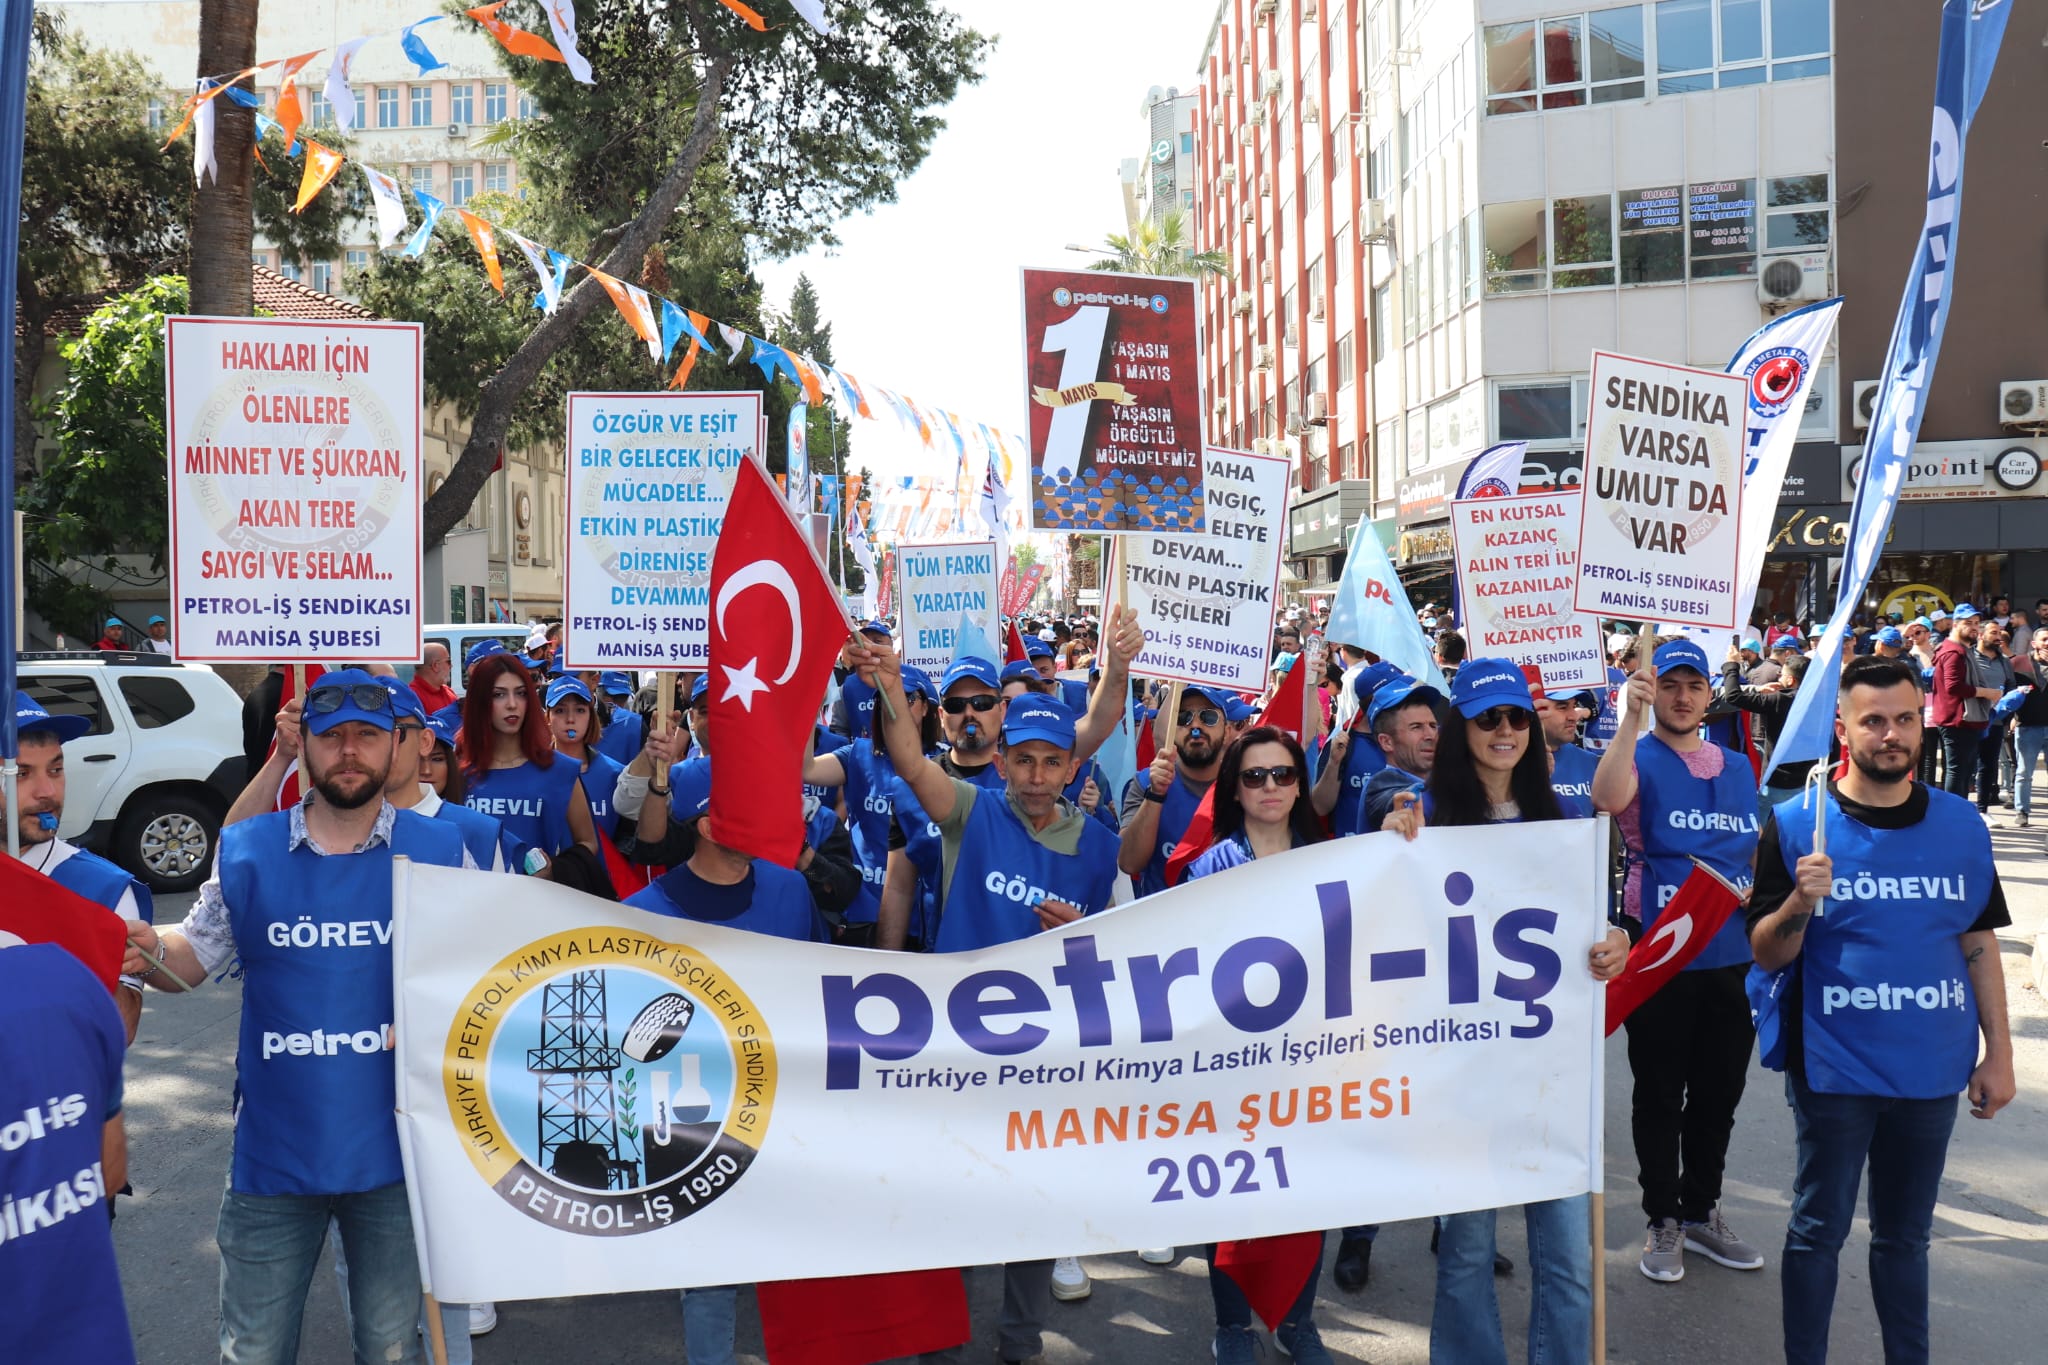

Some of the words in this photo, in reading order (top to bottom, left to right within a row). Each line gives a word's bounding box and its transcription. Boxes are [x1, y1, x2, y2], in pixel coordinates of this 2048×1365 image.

[1625, 199, 1679, 209] TRANSLATION
[1690, 194, 1718, 204] OFFICE
[1641, 189, 1679, 200] ULUSAL
[1073, 292, 1150, 309] petrol-iş
[222, 341, 315, 372] HAKLARI
[325, 336, 369, 381] İÇİN
[1110, 341, 1169, 362] YAŞASIN
[1757, 348, 1788, 363] METAL
[1114, 364, 1121, 378] 1
[1126, 364, 1171, 381] MAYIS
[243, 386, 350, 425] ÖLENLERE
[1060, 383, 1098, 406] MAYIS
[1605, 375, 1730, 428] SENDİKA
[592, 409, 663, 433] ÖZGÜR
[670, 414, 693, 433] VE
[700, 409, 738, 438] EŞİT
[1112, 405, 1171, 425] YAŞASIN
[1110, 423, 1175, 445] ÖRGÜTLÜ
[1619, 423, 1711, 469] VARSA
[185, 438, 271, 475] MİNNET
[279, 447, 305, 476] VE
[312, 440, 407, 484] ŞÜKRAN,
[581, 443, 612, 468] BİR
[619, 448, 700, 468] GELECEK
[1096, 445, 1196, 468] MÜCADELEMİZ
[1783, 475, 1805, 486] vice
[1907, 458, 1980, 481] point
[2001, 467, 2036, 476] Rental
[603, 478, 724, 502] MÜCADELE...
[1208, 488, 1266, 517] NGIÇ,
[1596, 466, 1680, 508] UMUT
[1688, 480, 1728, 516] DA
[238, 499, 300, 528] AKAN
[308, 500, 356, 529] TERE
[580, 512, 637, 536] ETKİN
[644, 511, 723, 537] PLASTİK
[1471, 508, 1494, 524] EN
[1500, 503, 1566, 522] KUTSAL
[1211, 519, 1268, 543] ELEYE
[1485, 528, 1557, 547] KAZANÇ
[1630, 517, 1687, 555] VAR
[201, 551, 265, 580] SAYGI
[272, 551, 298, 580] VE
[306, 552, 393, 580] SELAM...
[619, 547, 707, 576] DİRENİŞE
[905, 552, 940, 577] TÜM
[946, 554, 991, 576] FARKI
[1152, 538, 1243, 569] DEVAM...
[1468, 556, 1509, 573] ALIN
[1513, 549, 1550, 569] TERİ
[1188, 575, 1270, 603] PLASTİK
[1582, 563, 1652, 585] PETROL-İŞ
[1656, 572, 1731, 594] SENDİKASI
[185, 593, 290, 619] PETROL-İŞ
[299, 593, 411, 615] SENDİKASI
[913, 590, 986, 613] YARATAN
[1151, 595, 1232, 626] İŞÇİLERİ
[1503, 602, 1557, 620] HELAL
[1600, 590, 1657, 610] MANİSA
[1661, 596, 1710, 616] ŞUBESİ
[573, 613, 657, 634] PETROL-İŞ
[1484, 624, 1583, 646] KAZANÇTIR
[216, 625, 302, 647] MANİSA
[309, 625, 381, 651] ŞUBESİ
[597, 640, 665, 657] MANİSA
[670, 643, 711, 661] ŞUBE
[1143, 629, 1183, 649] OL-İŞ
[1186, 636, 1264, 660] SENDİKASI
[1190, 660, 1240, 679] ŞUBESİ
[1536, 649, 1598, 664] SENDİKASI
[1543, 666, 1583, 685] ŞUBESİ
[1553, 781, 1591, 798] REVLİ
[465, 795, 543, 817] ÖREVLİ
[1668, 808, 1760, 834] GÖREVLİ
[1830, 871, 1965, 902] GÖREVLİ
[267, 915, 393, 948] GÖREV
[510, 939, 582, 984] KİMYA
[588, 937, 665, 964] LASTİK
[669, 949, 747, 1021] İŞÇİLERİ
[821, 870, 1563, 1092] petrol-iş
[1823, 978, 1965, 1015] petrol-iş
[458, 982, 513, 1060] PETROL
[263, 1023, 392, 1060] petrol
[876, 1066, 988, 1093] Türkiye
[998, 1059, 1085, 1086] Petrol
[1095, 1055, 1183, 1085] Kimya
[1193, 1040, 1273, 1073] Lastik
[1282, 1027, 1366, 1066] İşçileri
[1372, 1017, 1502, 1049] Sendikası
[737, 1024, 765, 1133] SENDİKASI
[0, 1093, 87, 1151] ol-iş
[455, 1066, 500, 1163] TÜRKİYE
[1147, 1146, 1291, 1204] 2021
[510, 1174, 675, 1230] PETROL-İŞ
[679, 1153, 739, 1207] 1950
